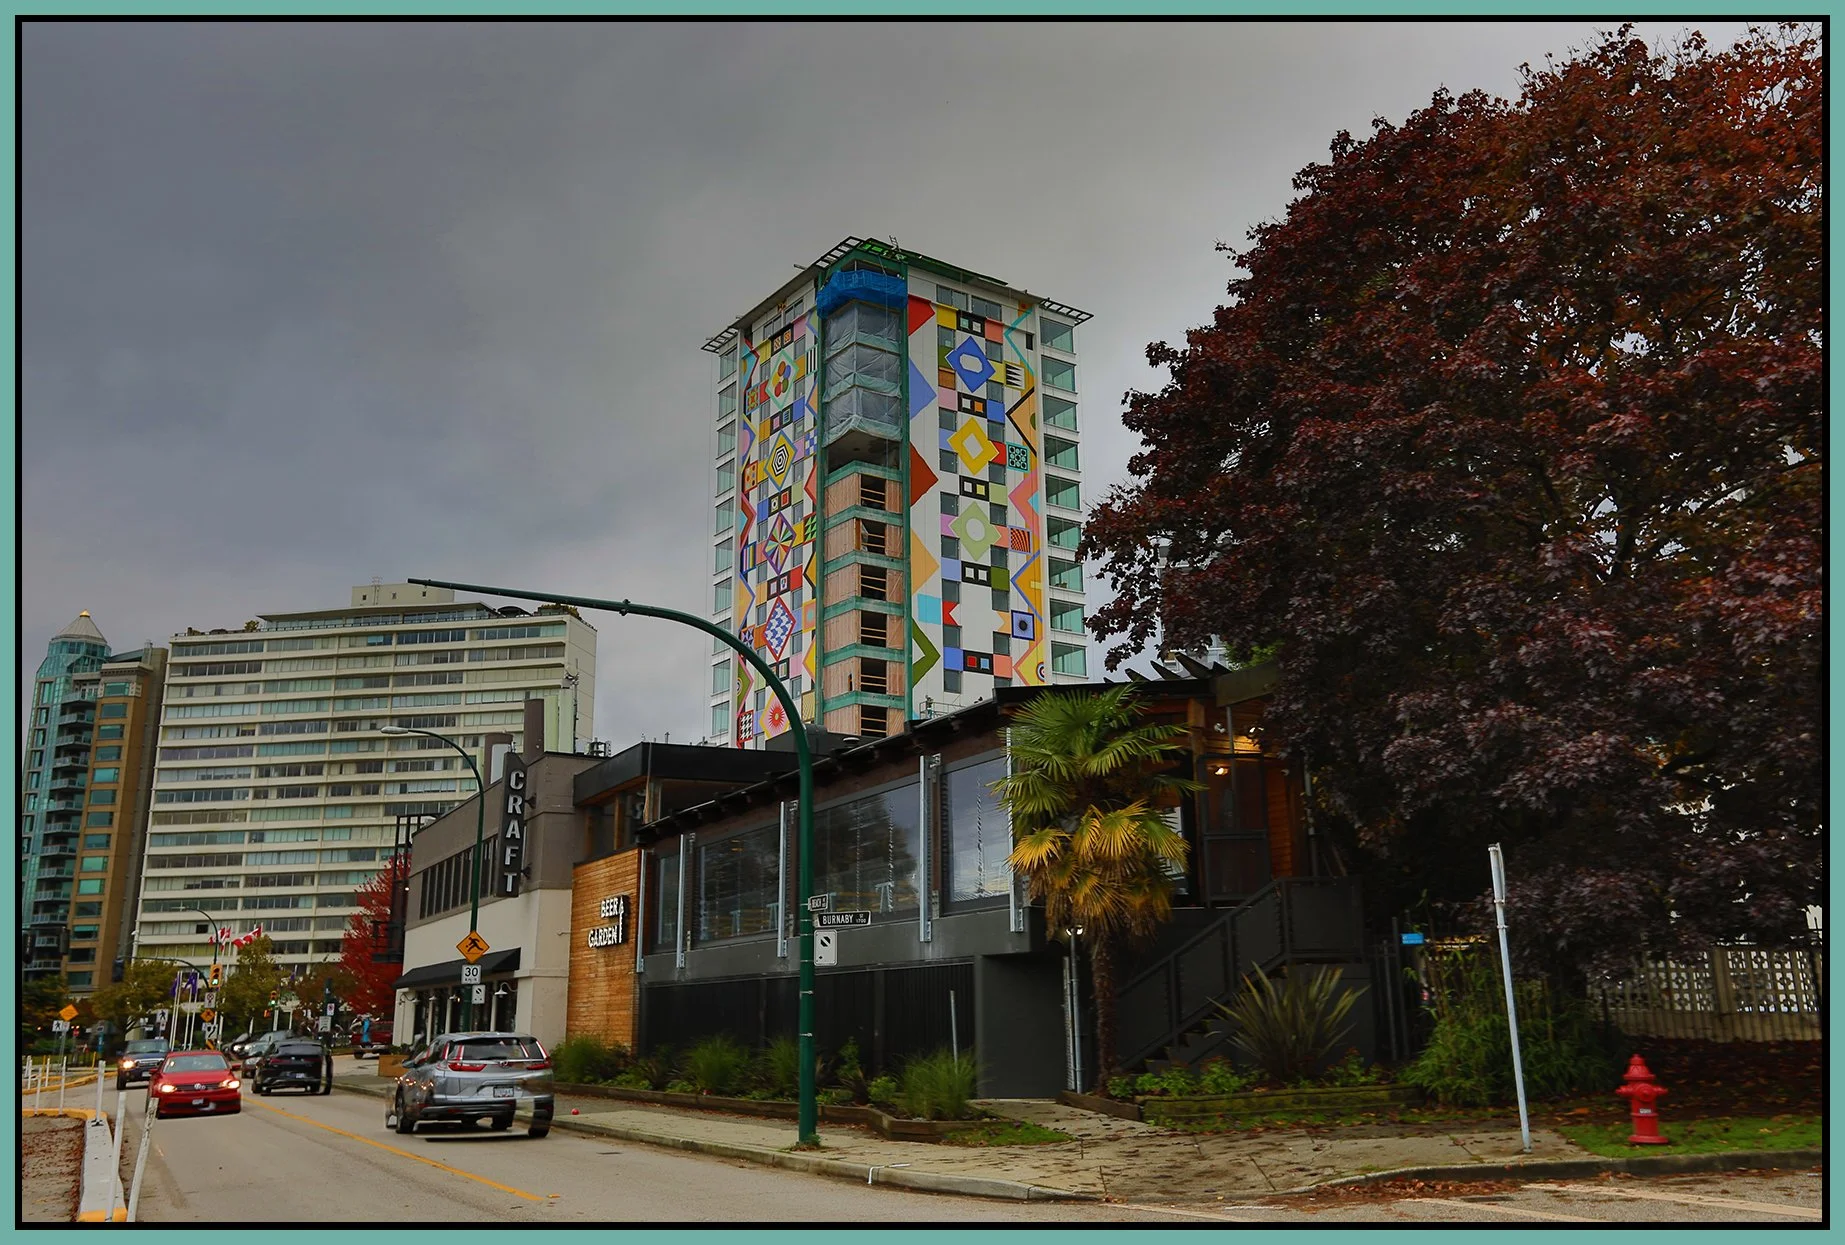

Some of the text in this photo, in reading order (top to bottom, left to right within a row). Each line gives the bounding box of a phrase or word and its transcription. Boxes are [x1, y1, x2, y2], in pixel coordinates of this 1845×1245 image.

[504, 770, 525, 892] CRAFT
[600, 897, 618, 918] BEER
[822, 914, 853, 924] BURNABY
[588, 925, 618, 948] GARDEN
[464, 967, 479, 977] 30
